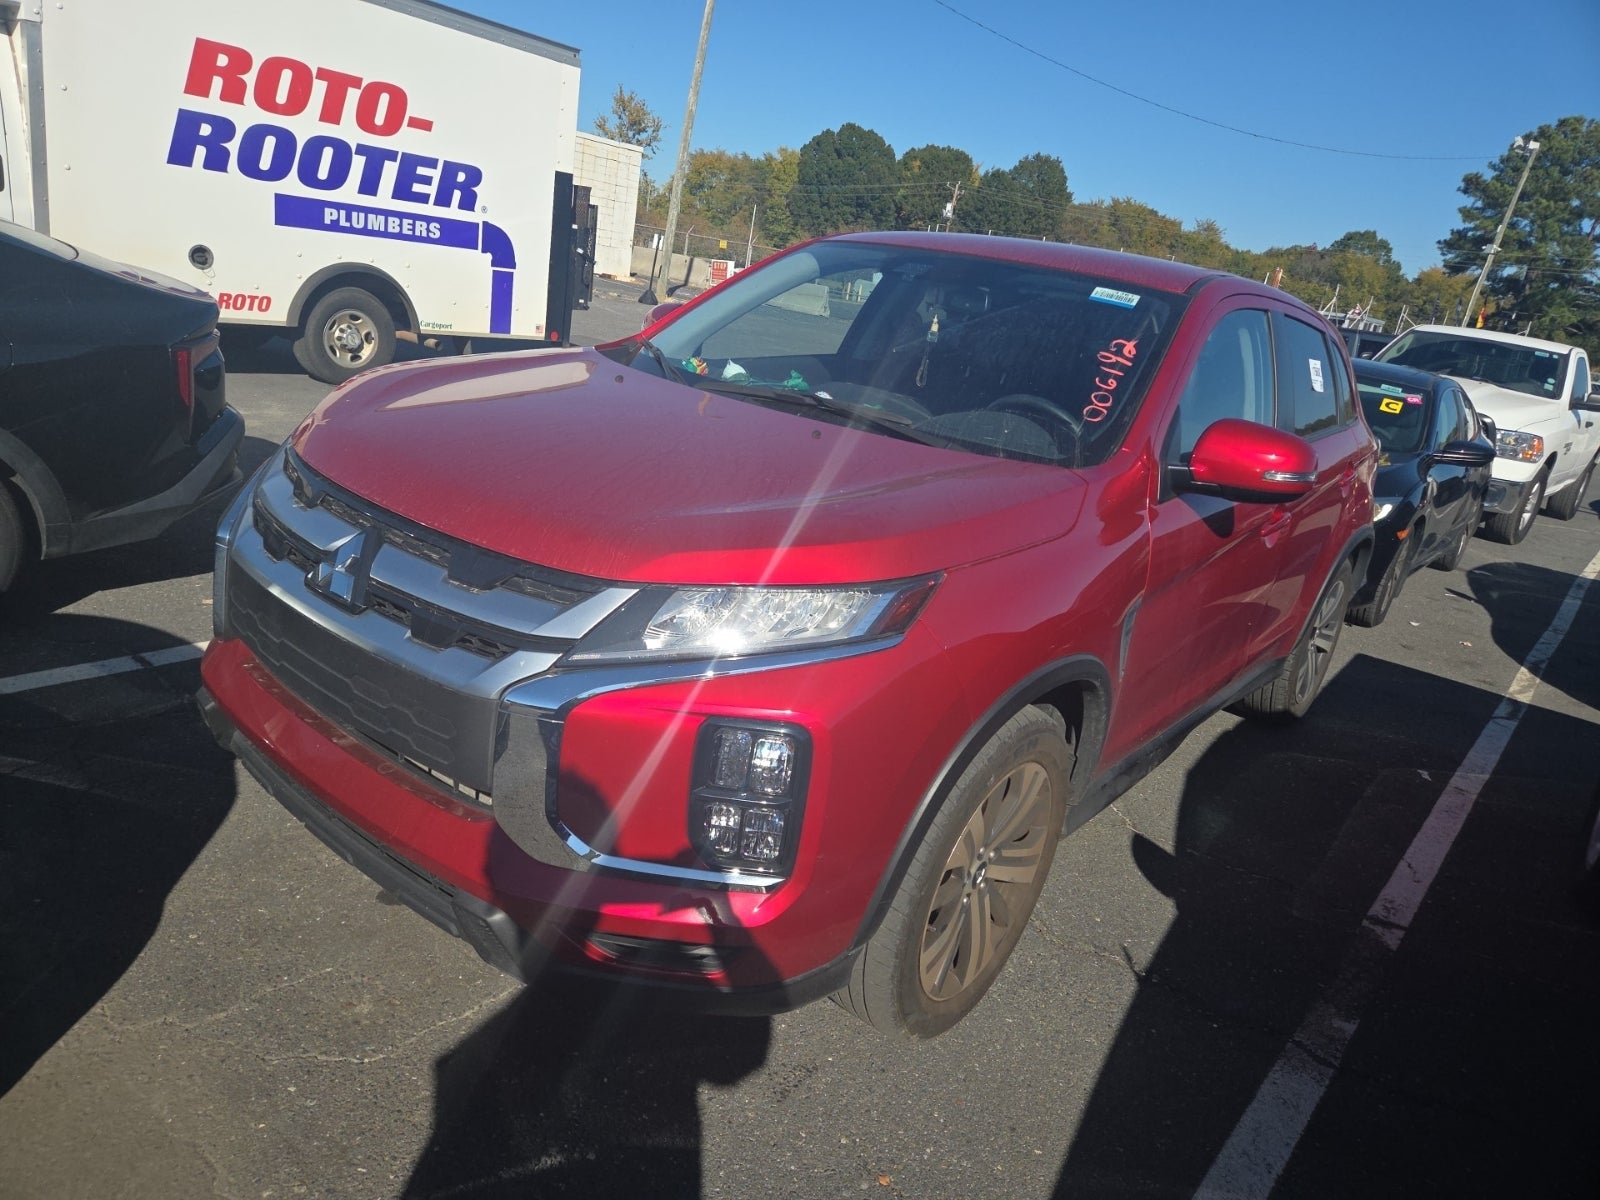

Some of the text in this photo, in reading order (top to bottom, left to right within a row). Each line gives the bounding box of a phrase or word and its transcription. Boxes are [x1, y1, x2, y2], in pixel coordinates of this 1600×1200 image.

[183, 37, 433, 137] ROTO-
[167, 109, 482, 212] ROOTER
[323, 207, 441, 240] PLUMBERS
[713, 262, 727, 270] STOP
[217, 292, 272, 313] ROTO
[420, 320, 453, 330] Cargoport
[1384, 401, 1399, 411] C
